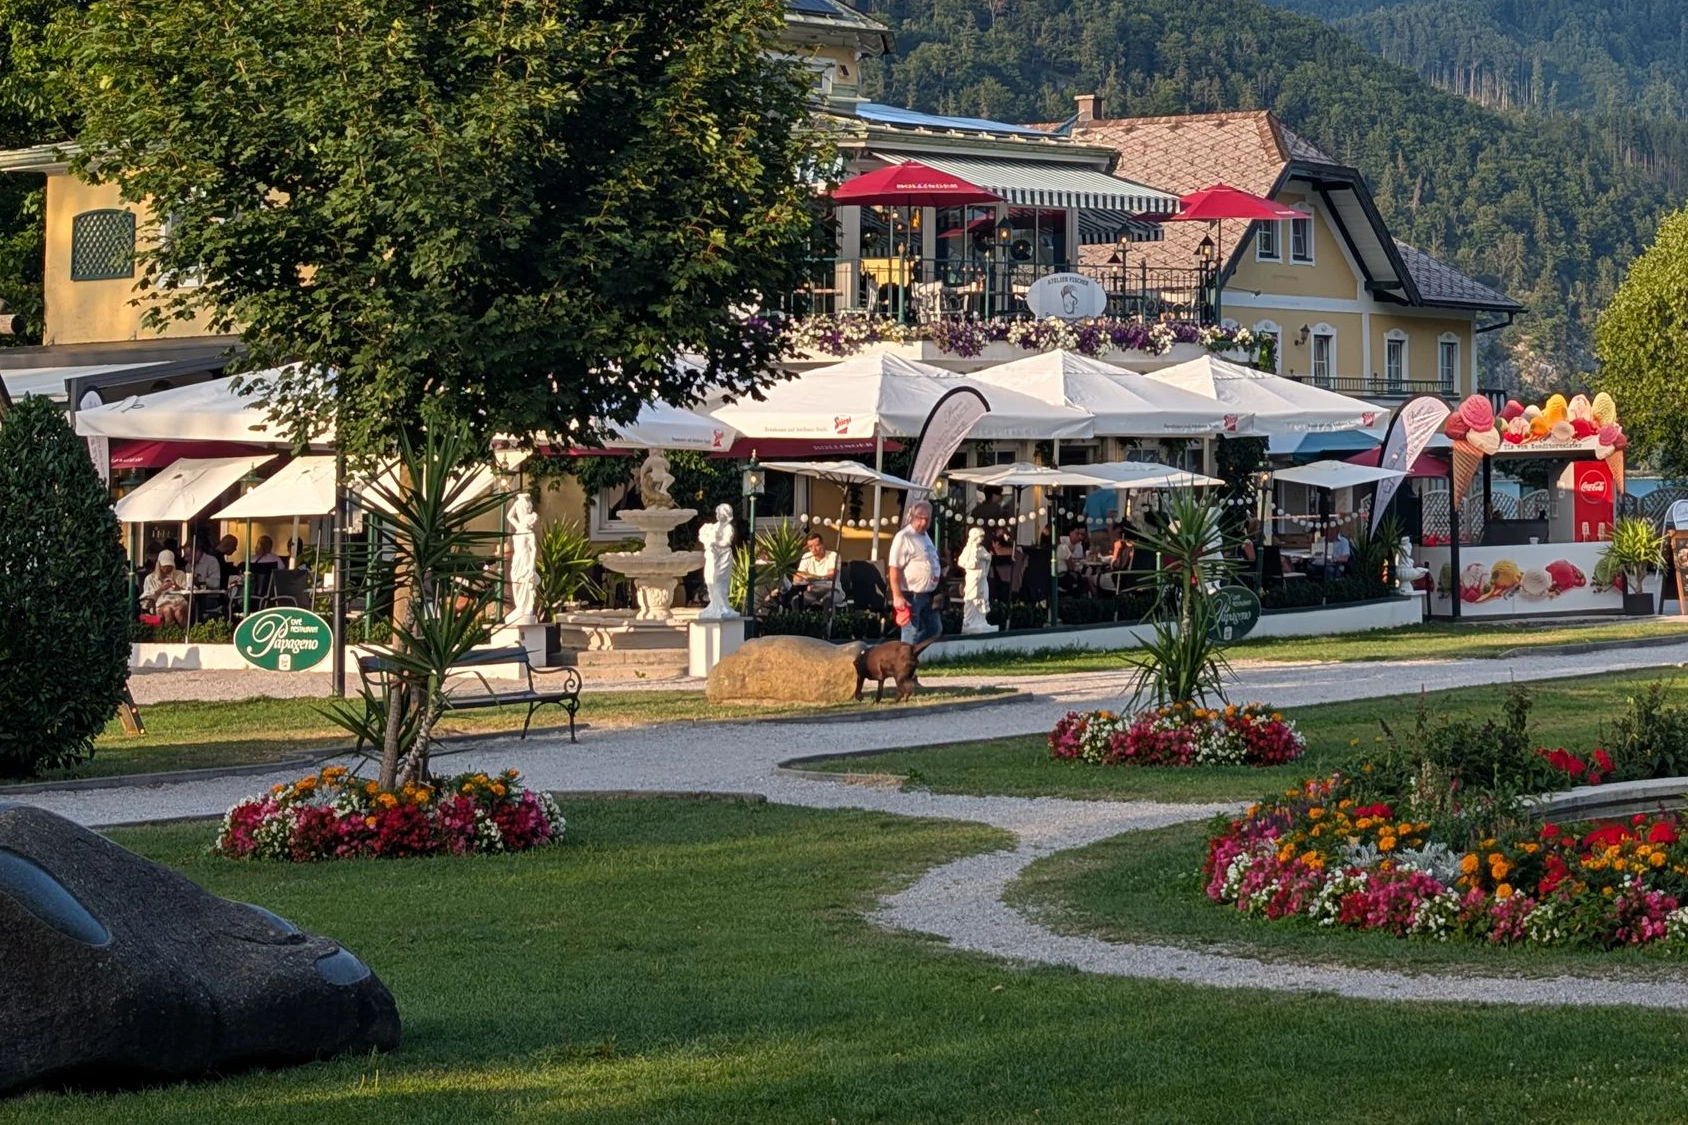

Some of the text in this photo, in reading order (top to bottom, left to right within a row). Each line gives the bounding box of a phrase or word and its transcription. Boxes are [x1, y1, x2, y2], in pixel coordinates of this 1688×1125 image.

[1048, 276, 1089, 286] ATELIER FISCHER
[834, 416, 851, 430] Stiegl
[1580, 480, 1605, 492] Coca-Cola
[246, 613, 319, 658] Papageno
